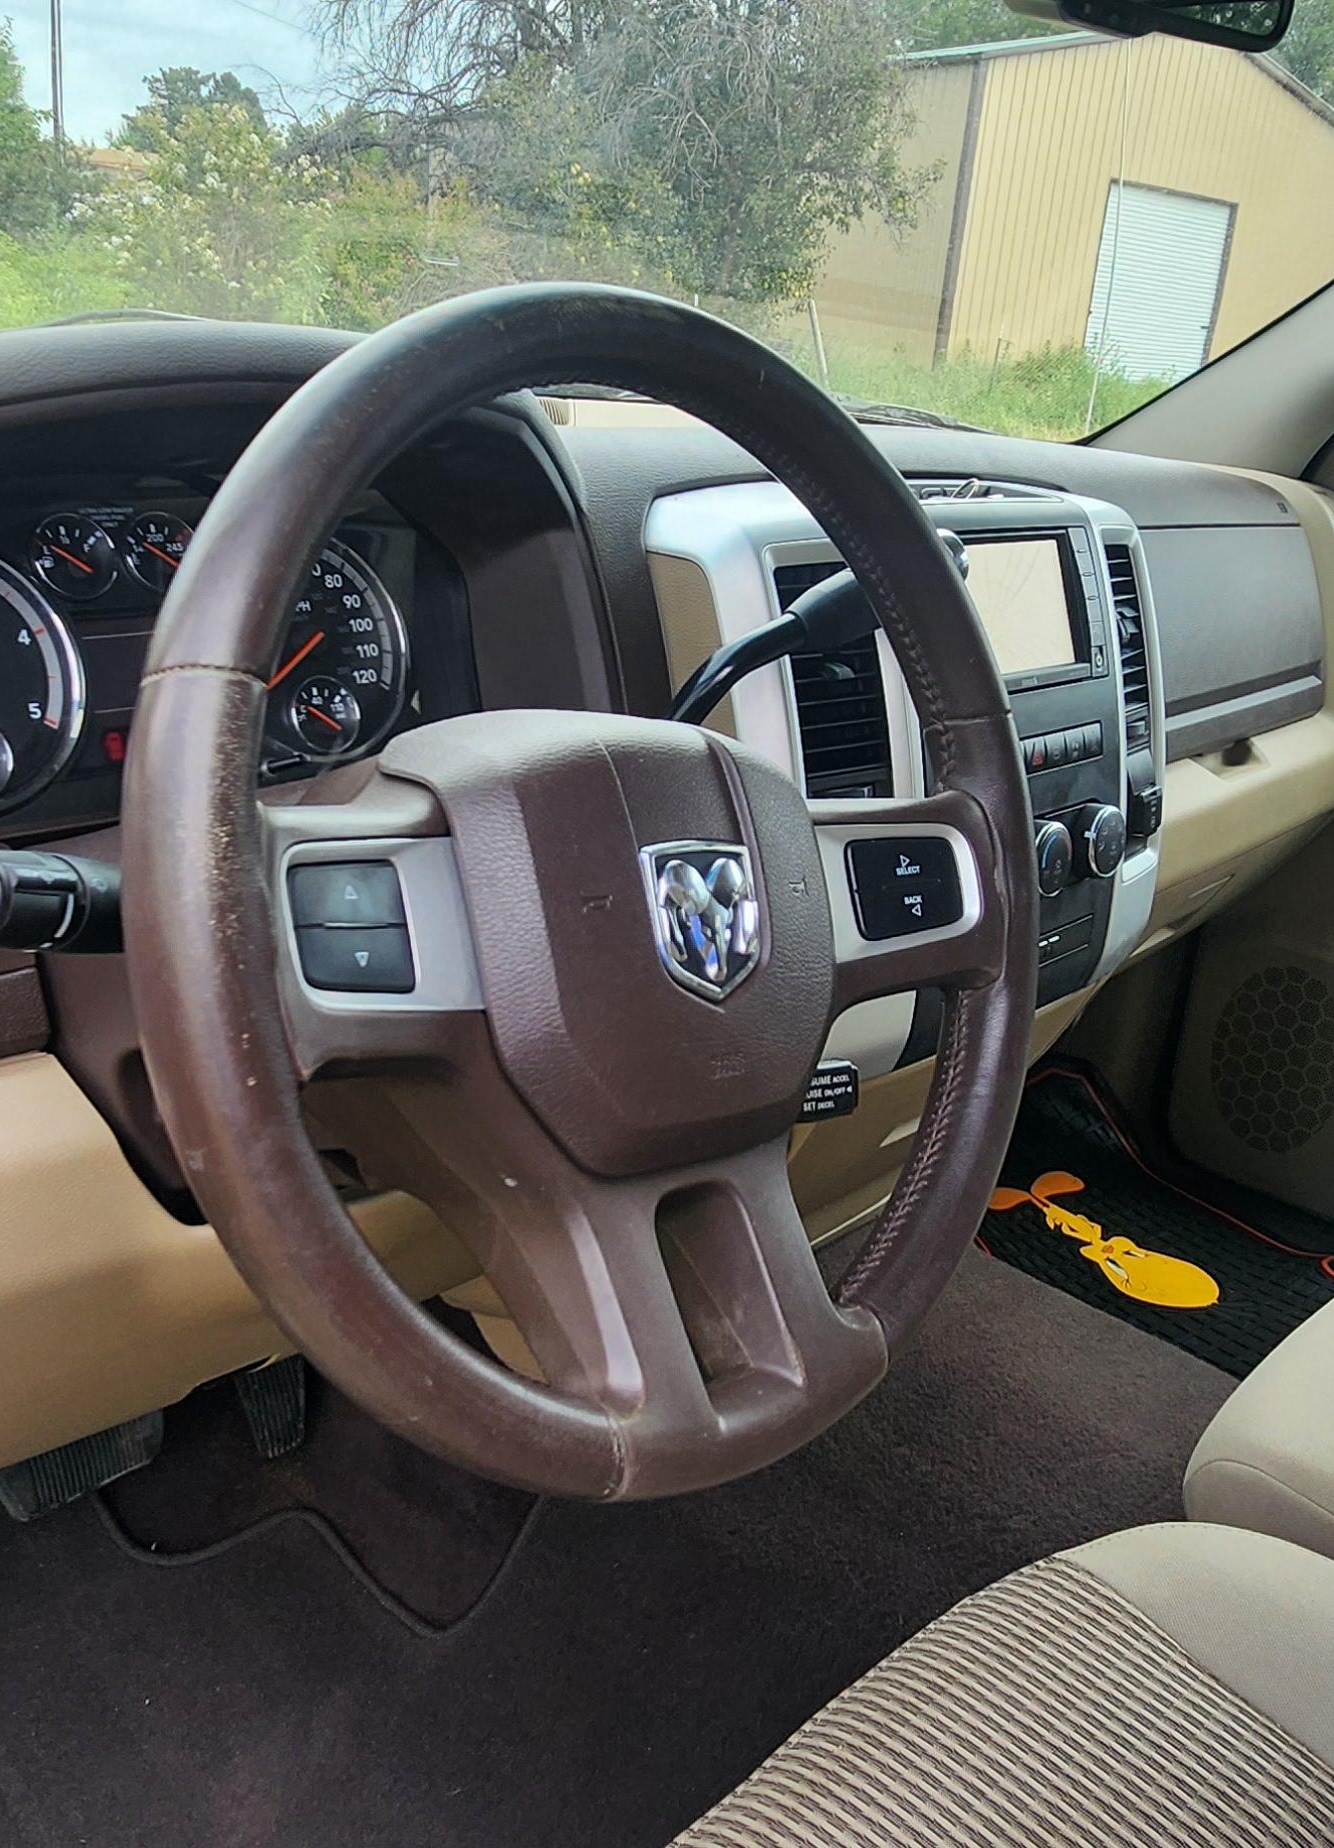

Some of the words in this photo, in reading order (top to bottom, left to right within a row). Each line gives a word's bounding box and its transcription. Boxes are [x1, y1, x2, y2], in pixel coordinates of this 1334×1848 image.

[146, 533, 165, 543] 200
[324, 573, 343, 589] 80
[342, 594, 361, 609] 90
[348, 617, 373, 633] 100
[17, 629, 32, 646] 4
[355, 642, 379, 659] 110
[352, 668, 378, 684] 120
[27, 702, 43, 719] 5
[895, 864, 921, 876] SELECT
[903, 894, 923, 905] BACK
[832, 1074, 851, 1084] ACCEL
[805, 1088, 823, 1099] UISE
[823, 1086, 846, 1097] ON/OFF
[803, 1101, 817, 1112] SET
[817, 1100, 835, 1110] DECEL
